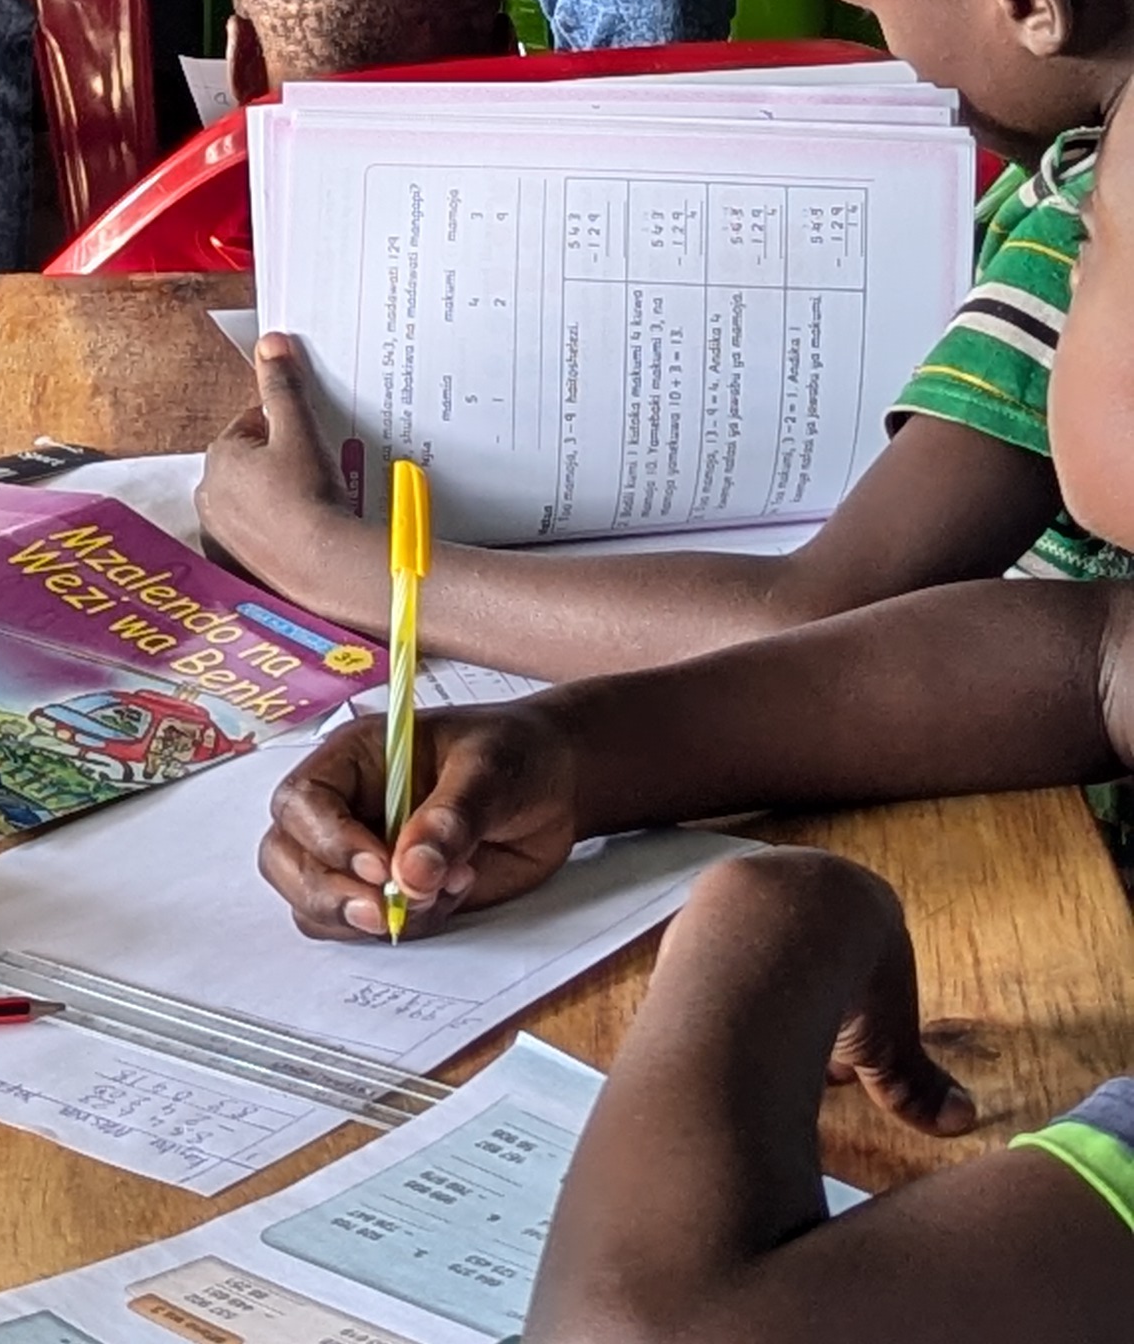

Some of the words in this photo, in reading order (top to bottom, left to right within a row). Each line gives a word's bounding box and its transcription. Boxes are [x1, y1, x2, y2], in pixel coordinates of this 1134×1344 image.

[446, 189, 462, 242] mamoja
[387, 236, 401, 259] 129
[441, 269, 456, 322] makumi
[405, 323, 416, 340] na
[668, 392, 682, 406] 10
[401, 410, 413, 444] shule
[48, 524, 244, 645] Mzalendo
[237, 641, 302, 679] na
[8, 538, 130, 615] Wezi
[108, 613, 179, 656] wa
[169, 647, 311, 725] Benki
